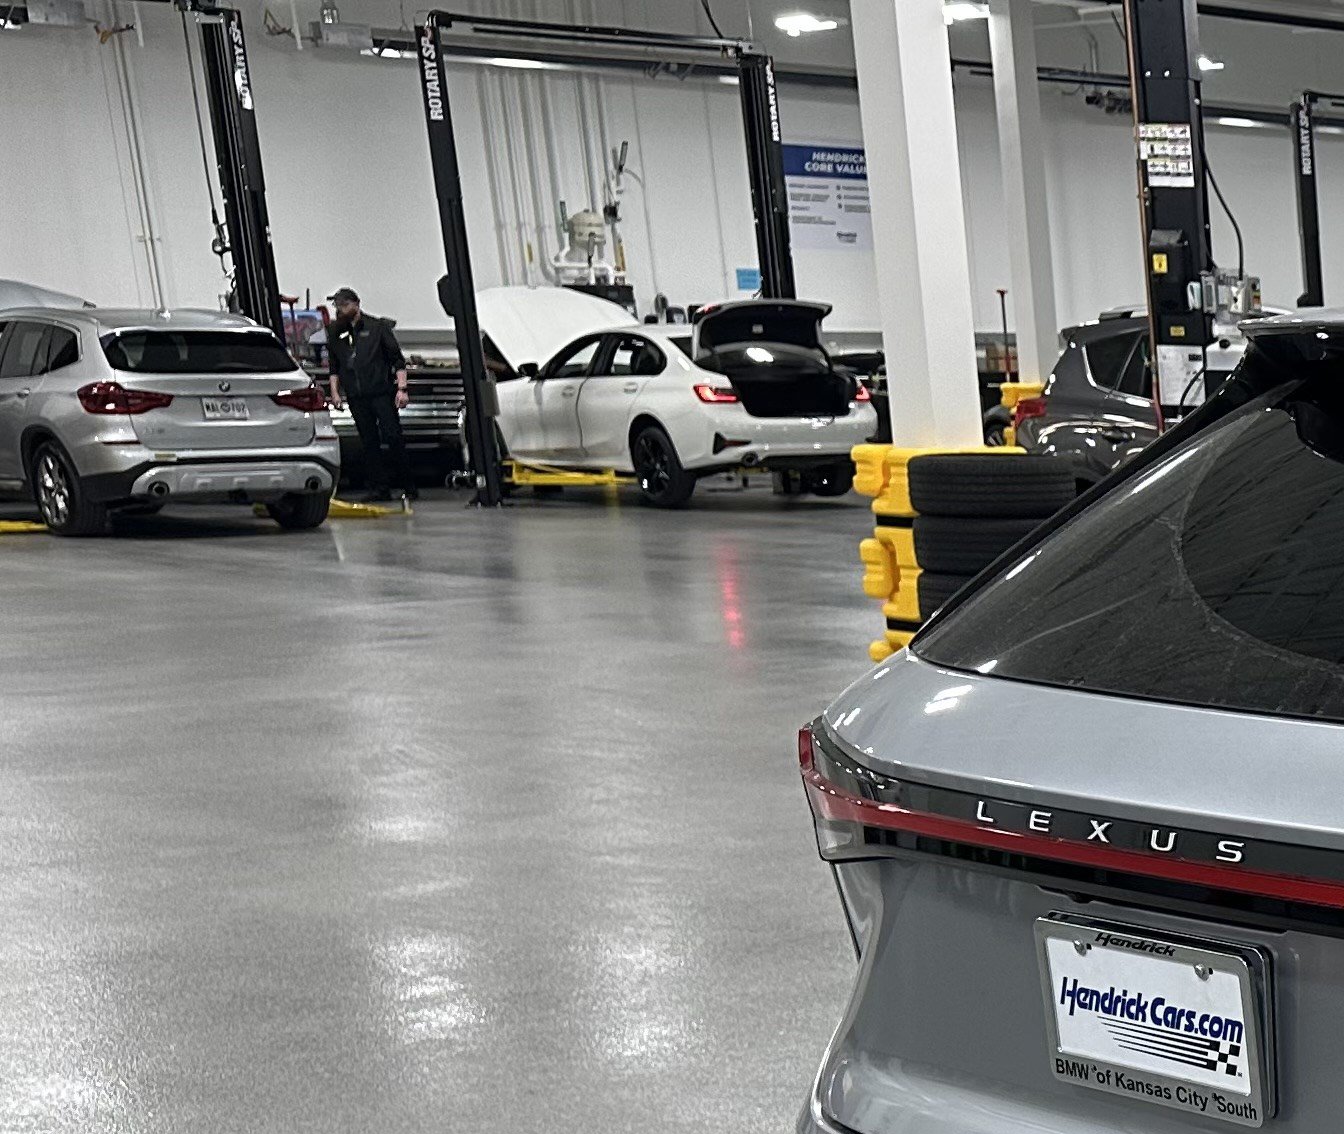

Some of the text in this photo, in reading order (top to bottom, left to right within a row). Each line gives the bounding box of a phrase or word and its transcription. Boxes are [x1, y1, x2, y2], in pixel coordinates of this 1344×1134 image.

[423, 58, 444, 120] ROTARY
[768, 85, 780, 141] ROTARY
[804, 161, 833, 172] CORE
[1300, 127, 1312, 175] ROTARY
[976, 800, 1245, 863] LEXUS
[1095, 932, 1176, 957] Hendrick
[1056, 1058, 1258, 1121] BMW of Kansas City South
